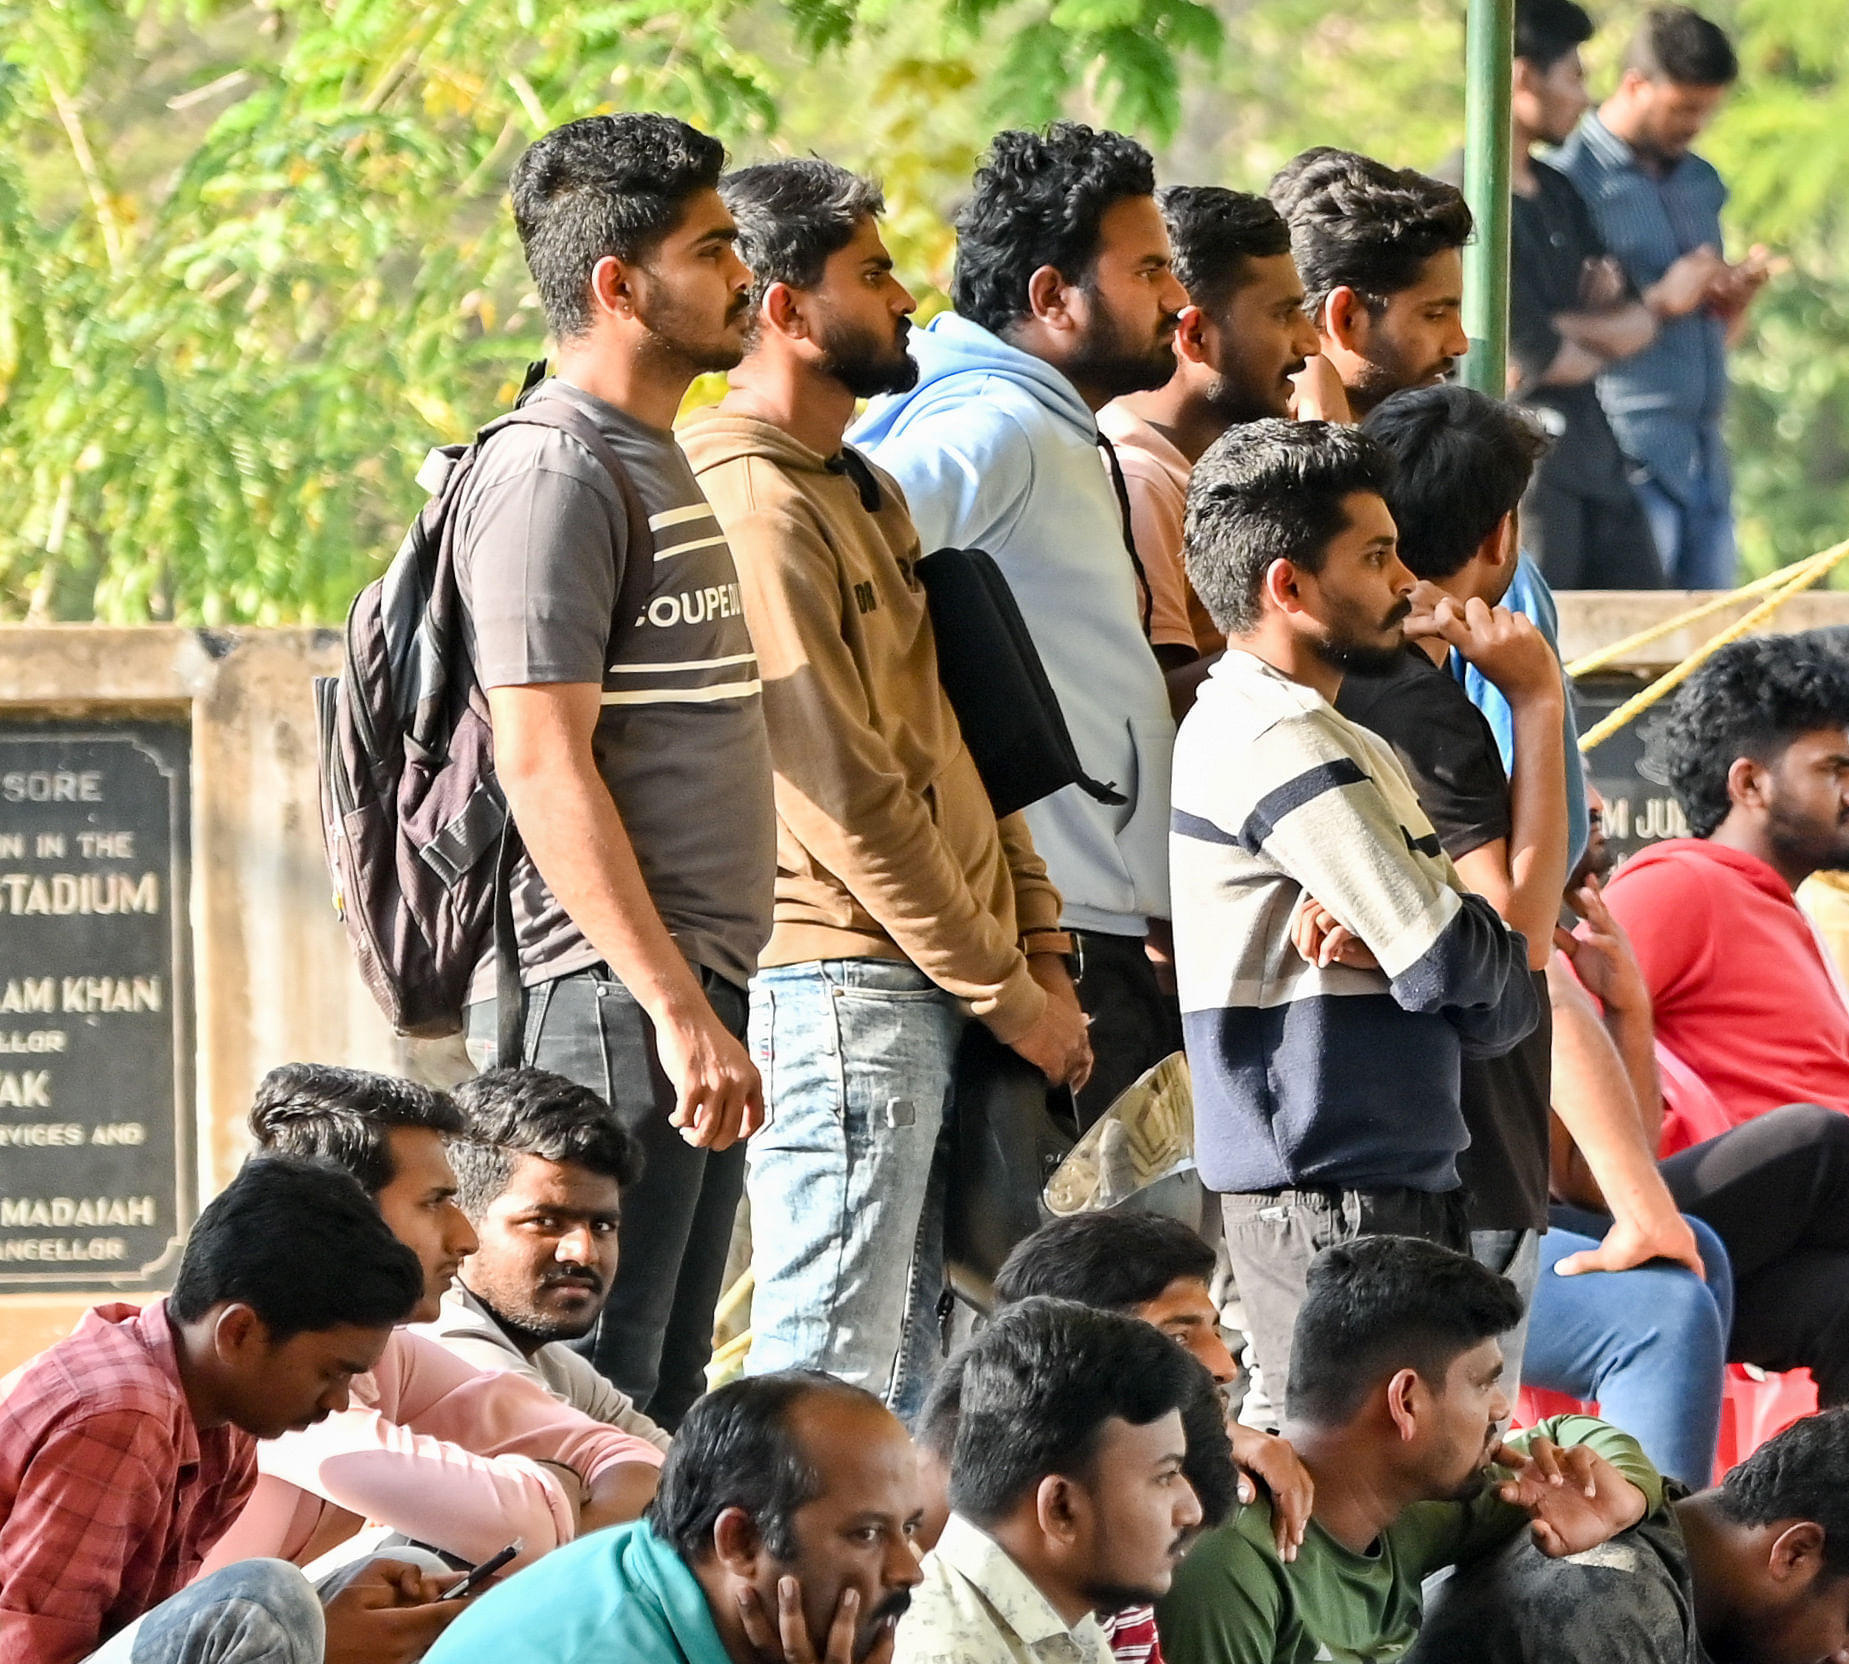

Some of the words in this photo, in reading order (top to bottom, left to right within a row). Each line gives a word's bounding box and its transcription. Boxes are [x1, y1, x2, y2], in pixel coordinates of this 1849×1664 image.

[2, 770, 104, 803] SORE
[36, 831, 67, 859] IN
[77, 830, 136, 859] THE
[0, 872, 160, 916] TADIUM
[62, 975, 163, 1013] KHAN
[0, 1069, 51, 1108] AK
[91, 1122, 147, 1146] AND
[1, 1196, 156, 1227] MADAIAH
